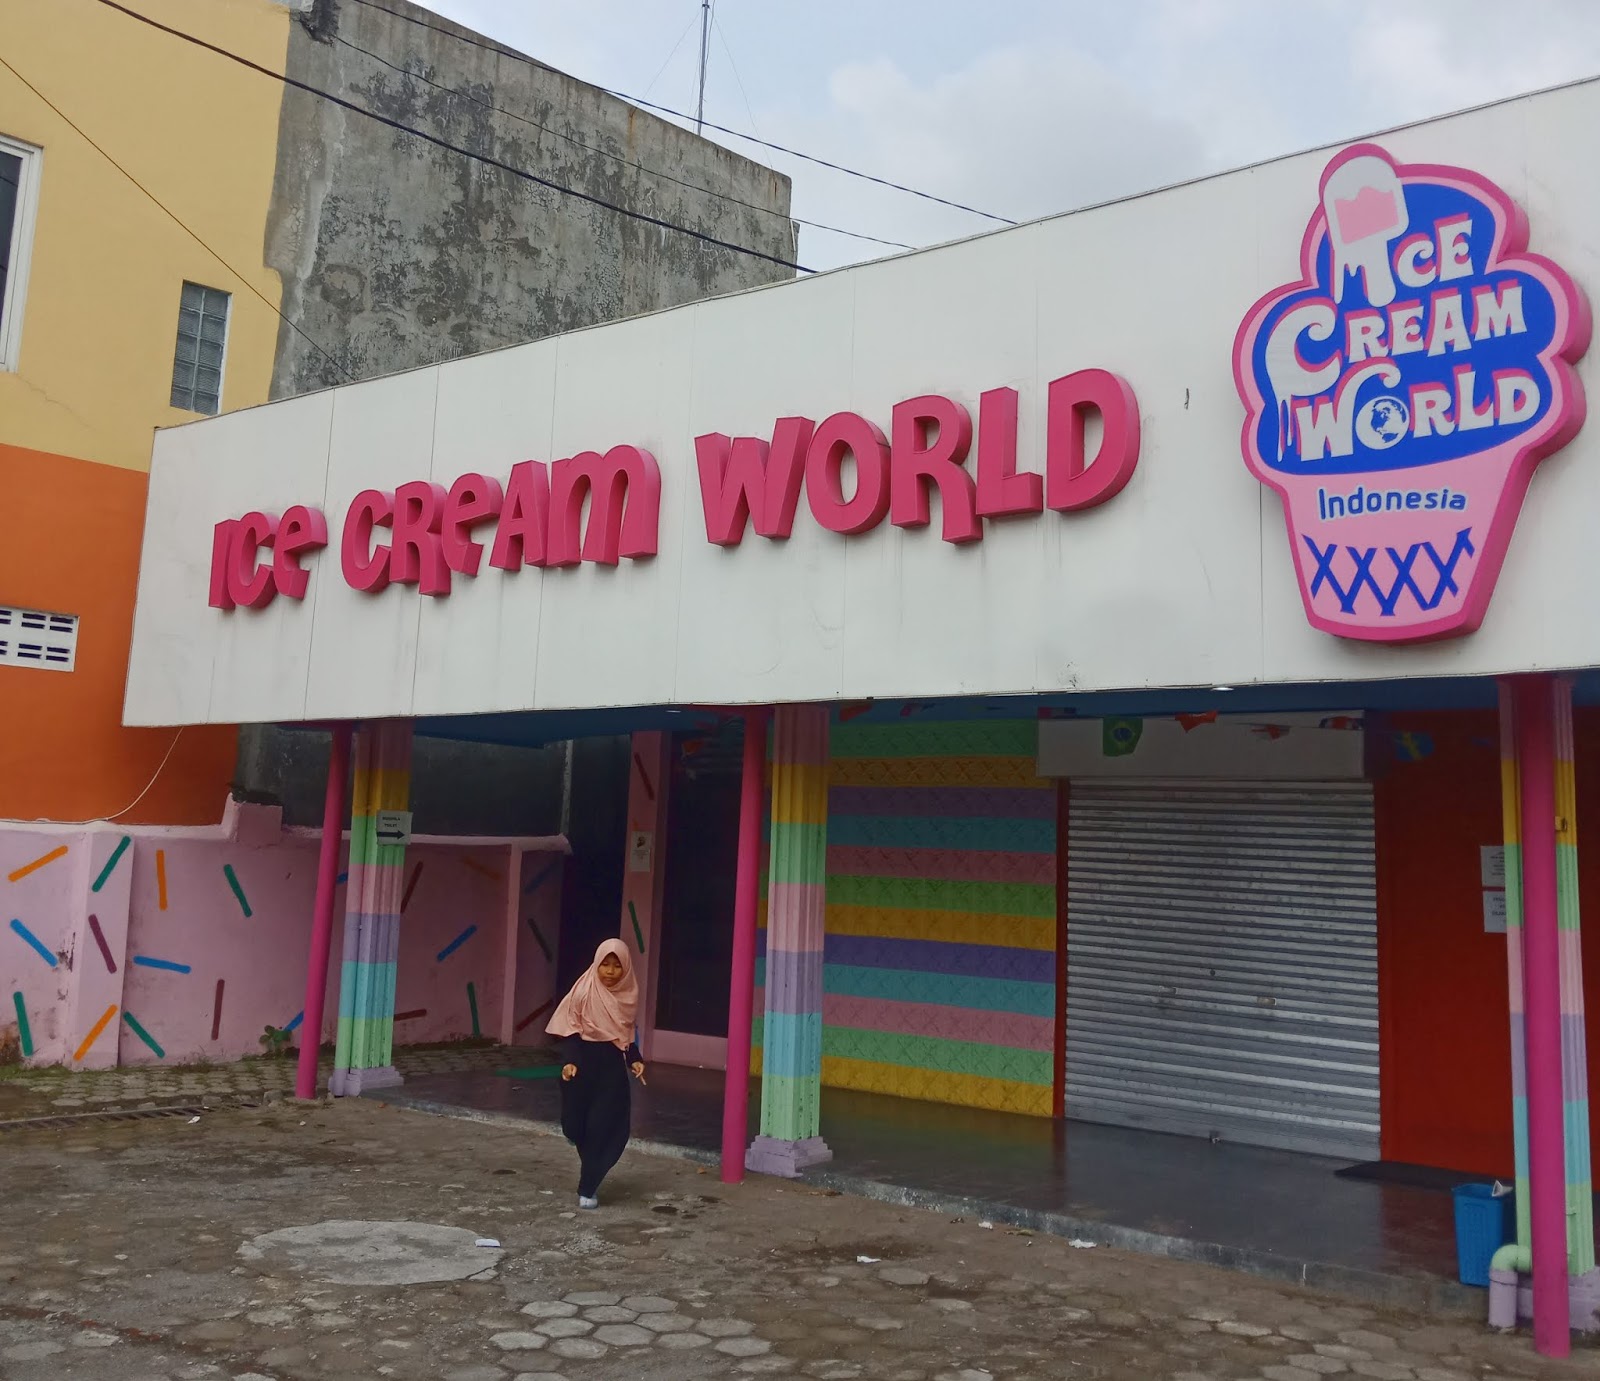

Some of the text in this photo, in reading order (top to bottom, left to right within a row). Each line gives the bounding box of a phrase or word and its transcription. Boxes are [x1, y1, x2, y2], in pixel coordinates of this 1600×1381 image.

[1325, 160, 1474, 307] ICE
[1265, 280, 1528, 410] CREAM
[694, 368, 1140, 545] WORLD
[1295, 363, 1541, 462] WORLD
[1319, 487, 1467, 521] Indonesia
